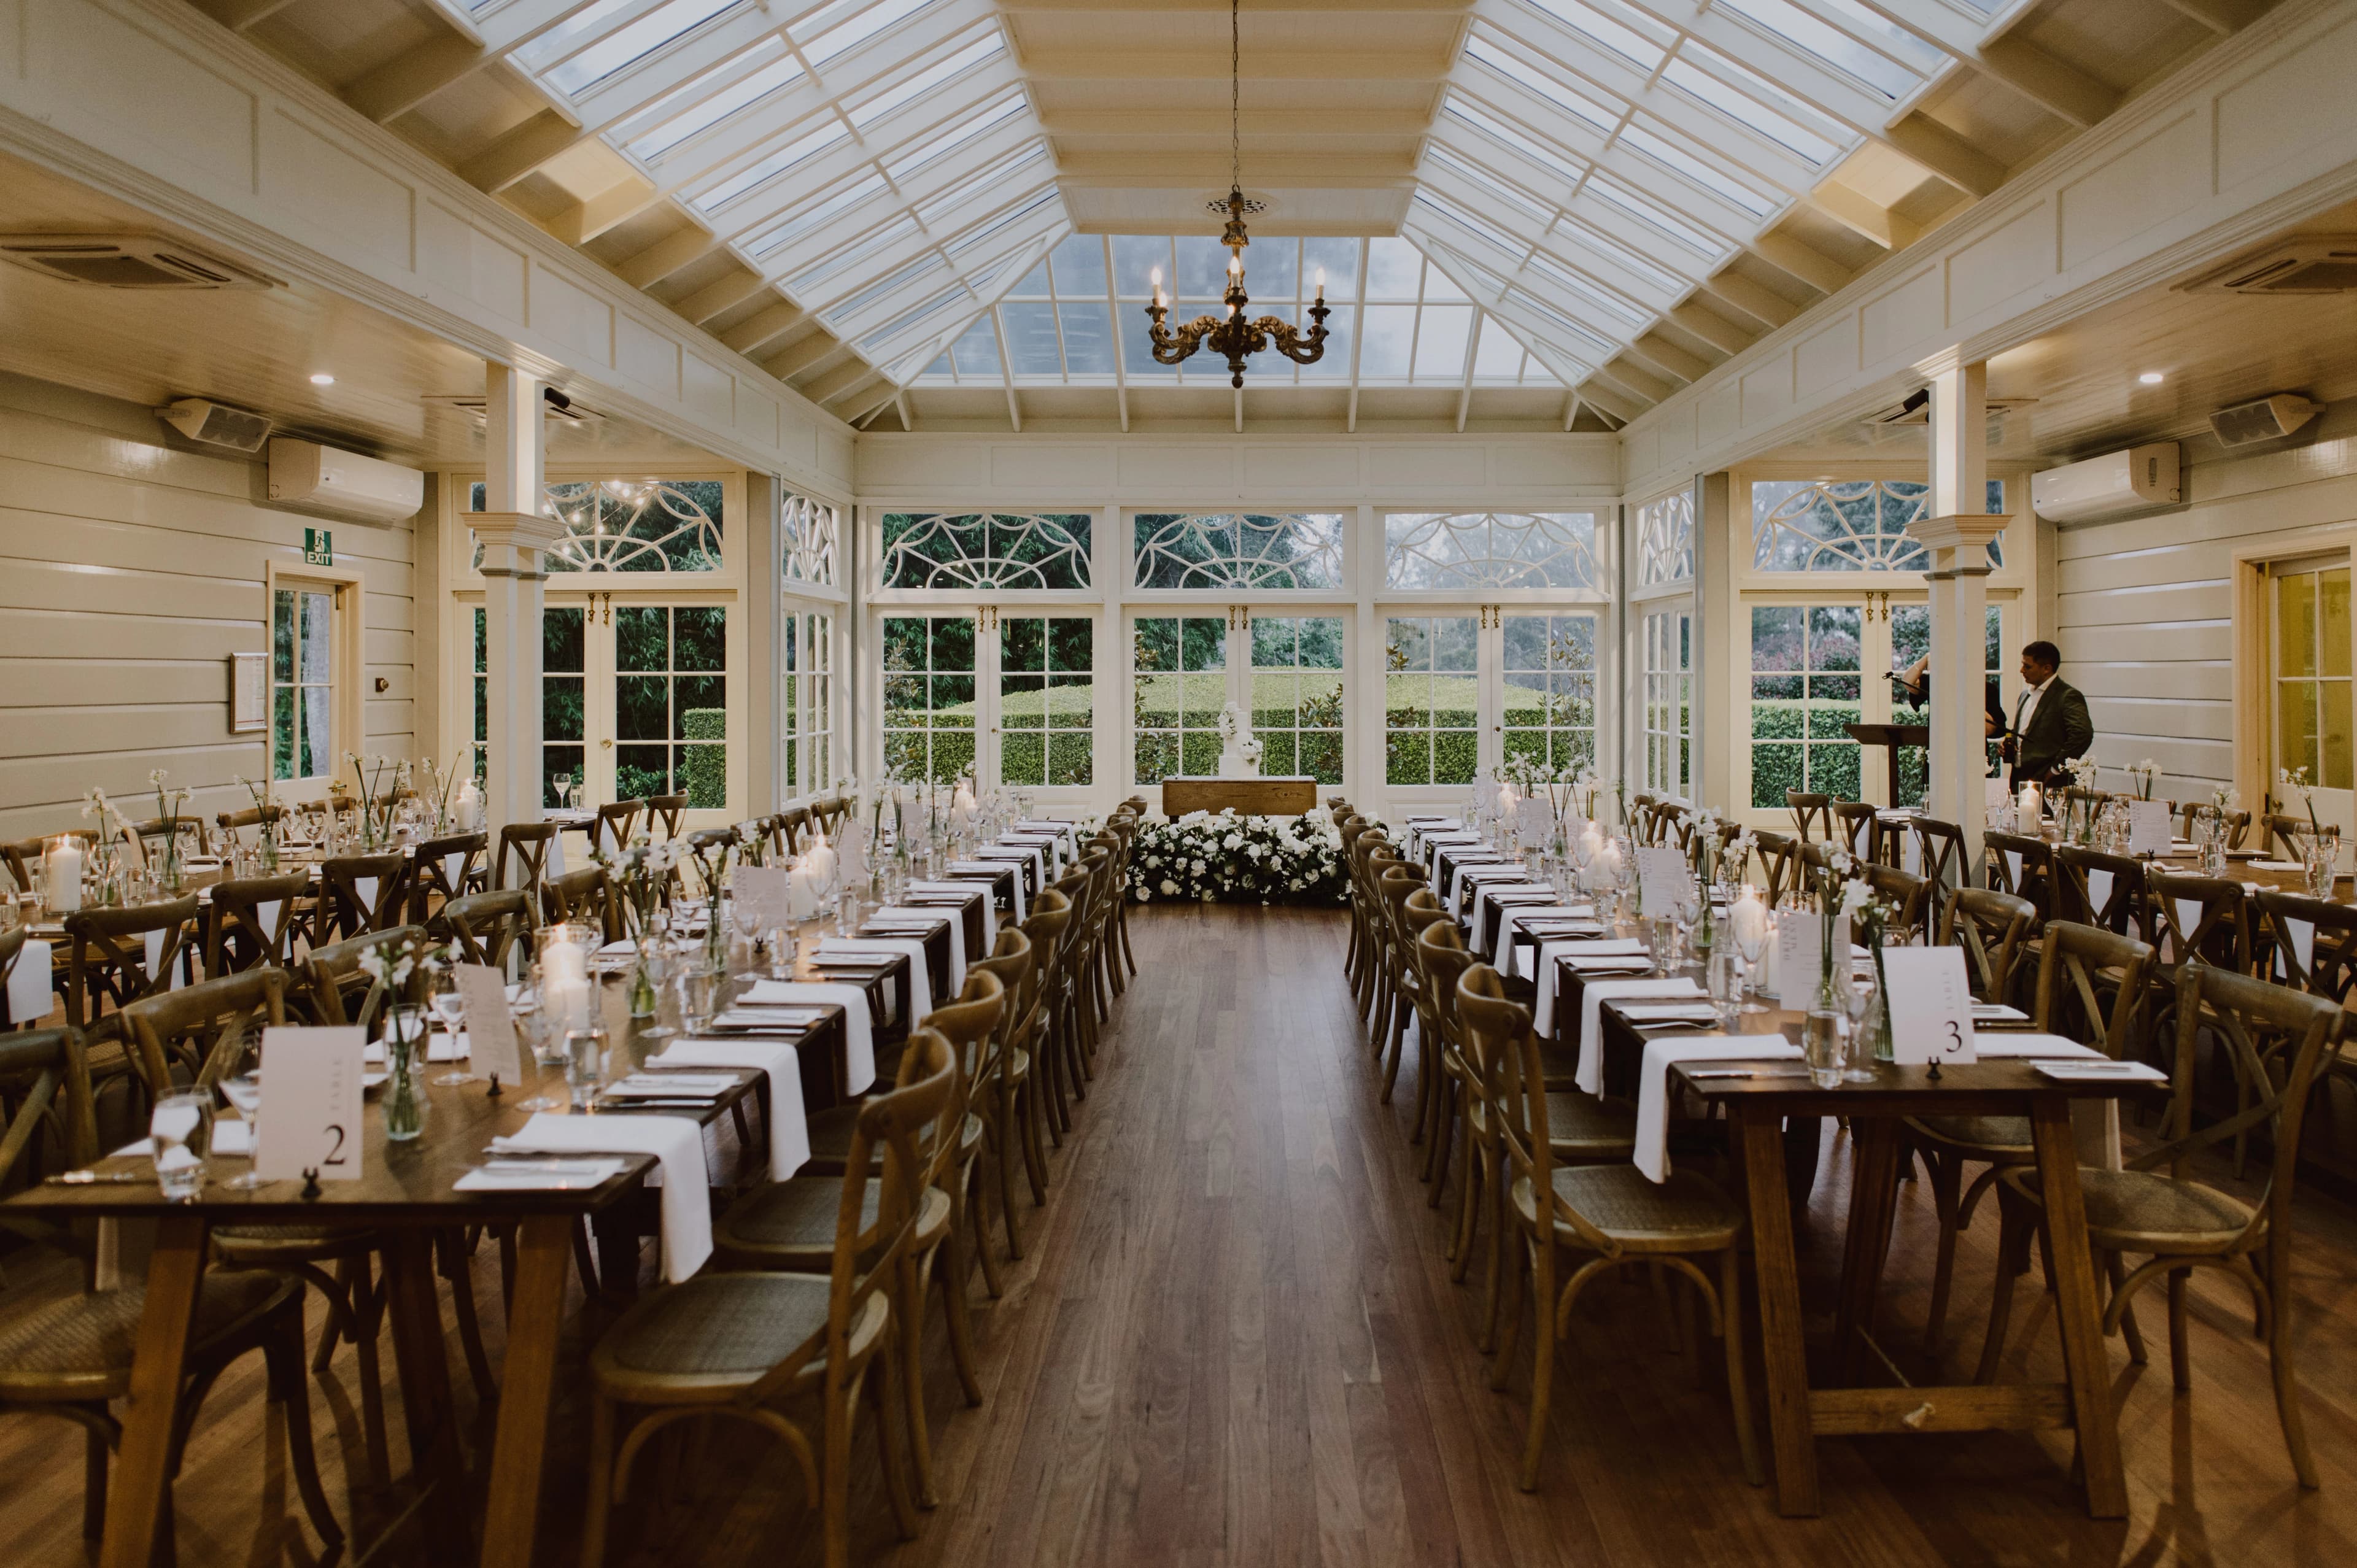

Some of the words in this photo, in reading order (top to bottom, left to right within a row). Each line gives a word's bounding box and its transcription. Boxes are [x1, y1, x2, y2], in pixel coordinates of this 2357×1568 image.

[308, 552, 330, 565] EXIT
[1944, 1021, 1962, 1053] 3
[323, 1124, 347, 1165] 2
